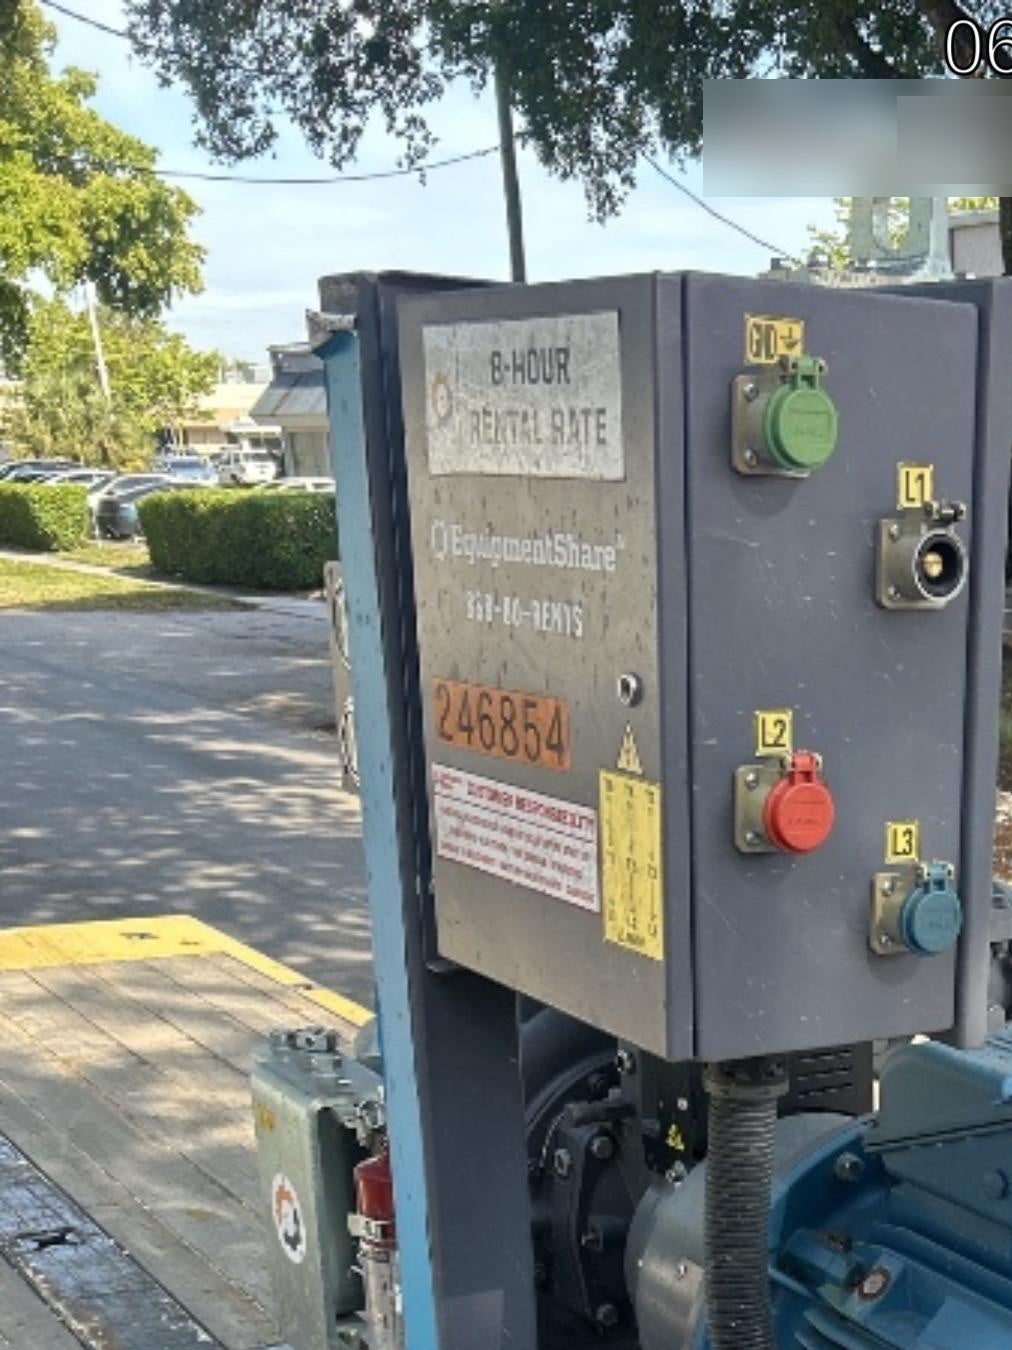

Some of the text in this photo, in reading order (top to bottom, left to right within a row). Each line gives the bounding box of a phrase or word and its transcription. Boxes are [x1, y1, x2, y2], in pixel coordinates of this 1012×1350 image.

[489, 347, 571, 385] 8-HOUR
[551, 406, 608, 446] RATE
[905, 470, 925, 503] L1
[437, 683, 566, 767] 246854
[761, 719, 787, 748] L2
[893, 828, 914, 857] L3
